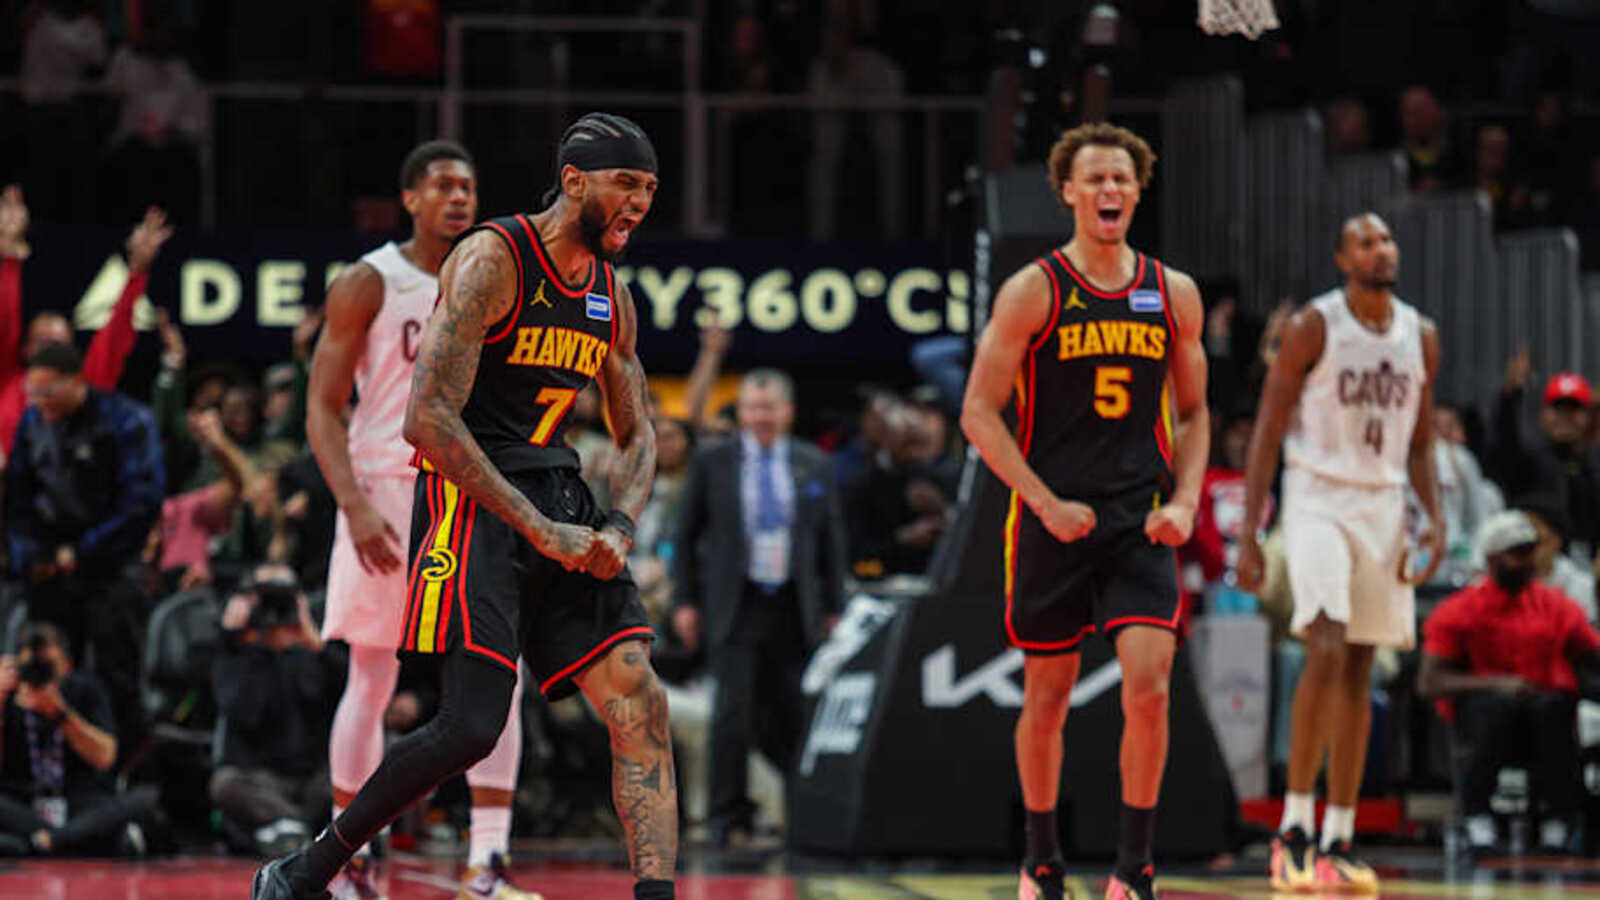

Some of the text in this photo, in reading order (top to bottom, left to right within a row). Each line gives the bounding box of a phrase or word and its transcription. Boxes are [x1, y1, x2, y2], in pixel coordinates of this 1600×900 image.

[181, 260, 346, 326] DE
[507, 325, 608, 378] HAWKS
[1057, 320, 1166, 361] HAWKS
[1094, 365, 1133, 419] 5
[1338, 361, 1410, 408] CAVS
[529, 387, 578, 447] 7
[1365, 418, 1384, 456] 4
